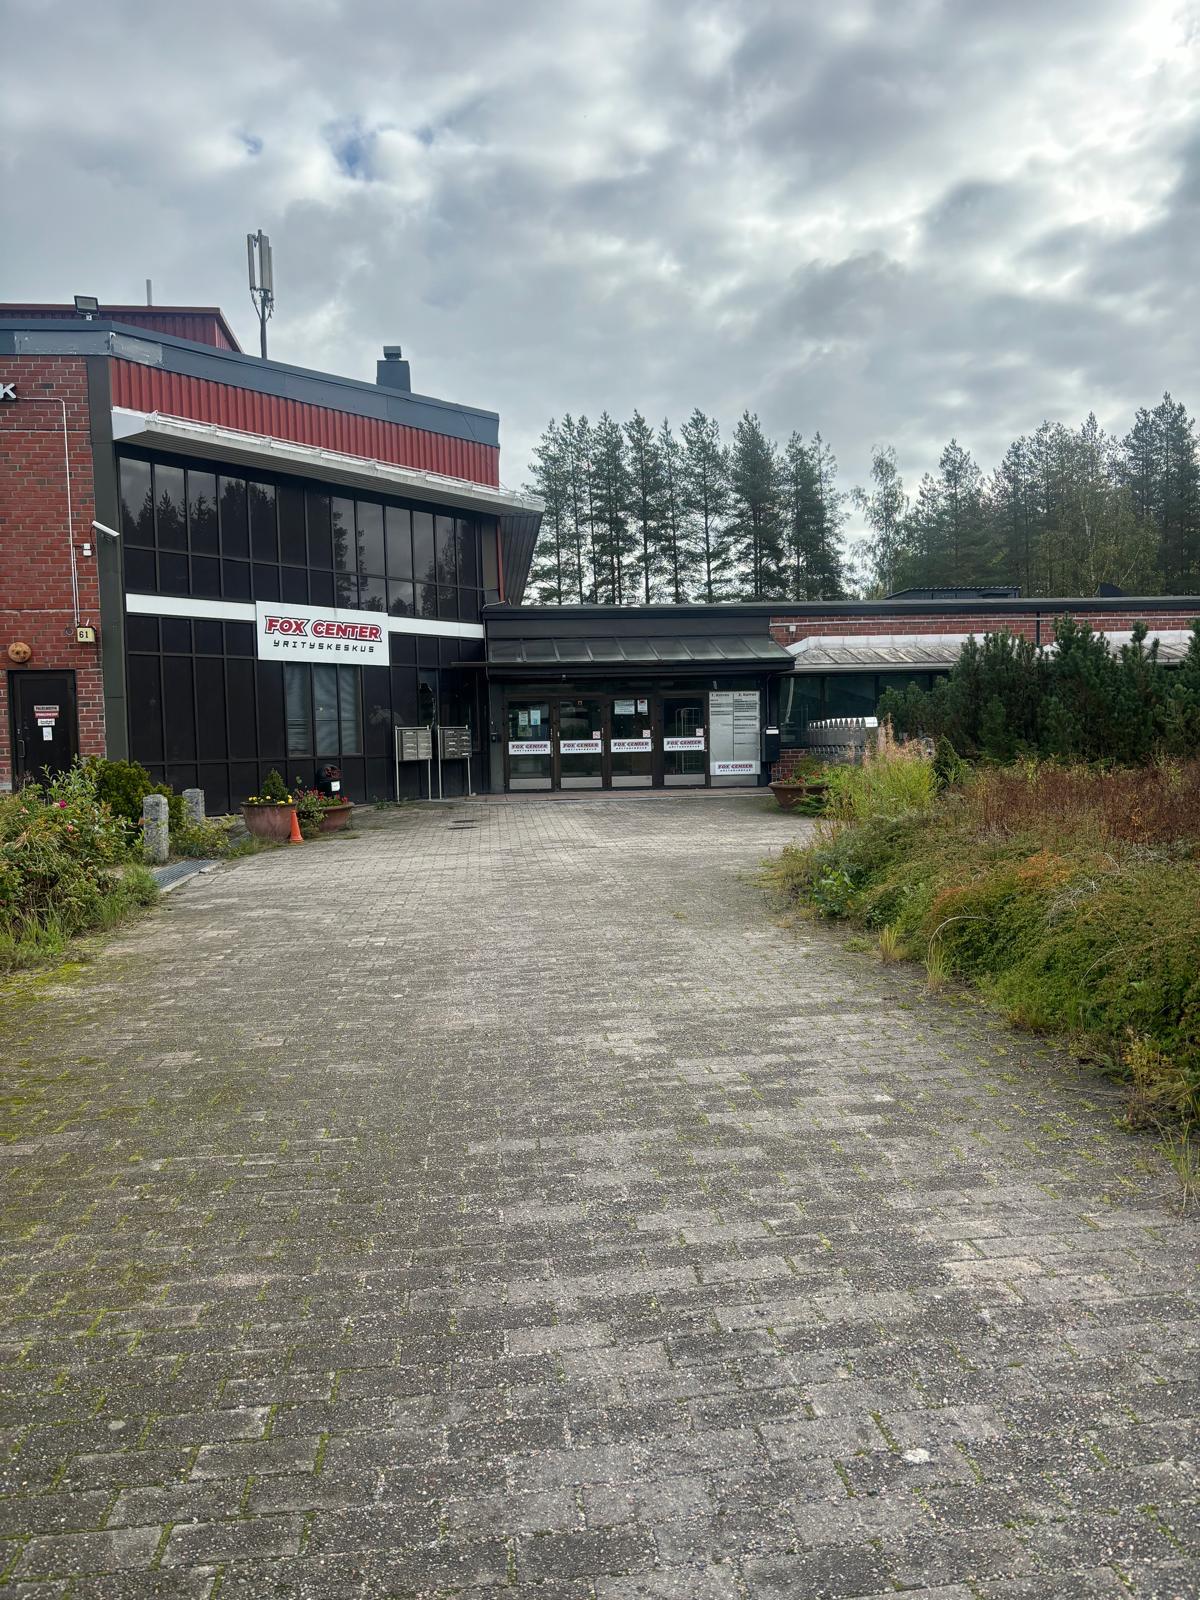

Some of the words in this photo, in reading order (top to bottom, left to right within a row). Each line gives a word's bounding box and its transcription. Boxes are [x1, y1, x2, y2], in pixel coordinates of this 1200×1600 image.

[265, 615, 310, 637] FOX
[311, 619, 383, 642] CENTER
[273, 639, 375, 653] YRITYSKESKUS
